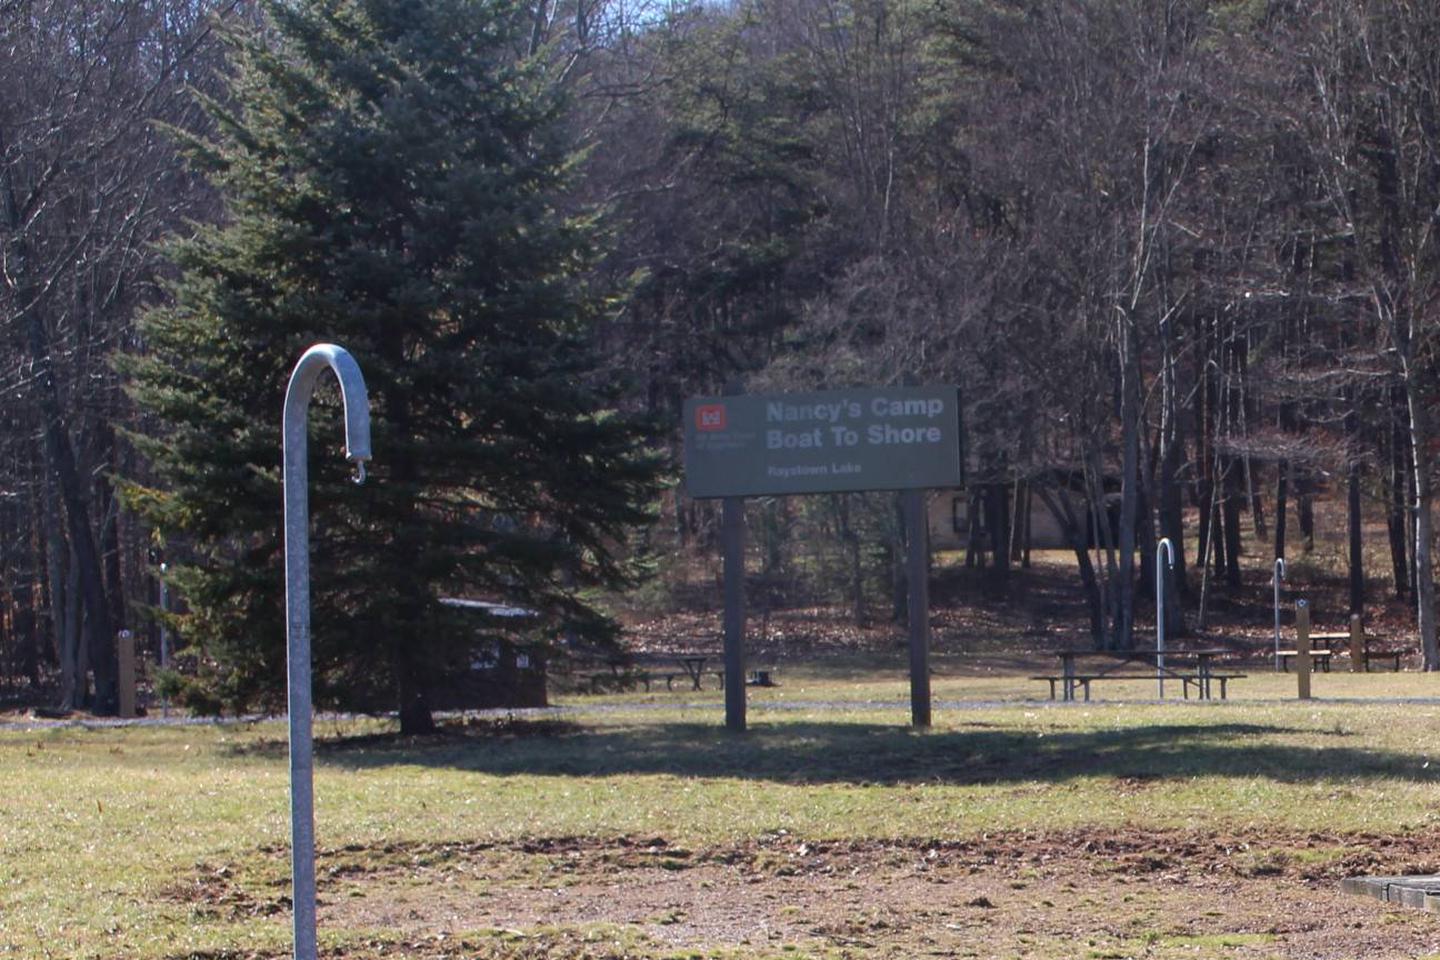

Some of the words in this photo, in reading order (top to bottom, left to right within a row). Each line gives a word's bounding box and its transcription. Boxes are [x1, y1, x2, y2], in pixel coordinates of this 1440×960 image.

[767, 399, 862, 423] Nancy's
[871, 397, 944, 418] Camp
[767, 428, 823, 449] Boat
[831, 426, 858, 446] To
[868, 424, 942, 445] Shore
[832, 463, 862, 474] Lake
